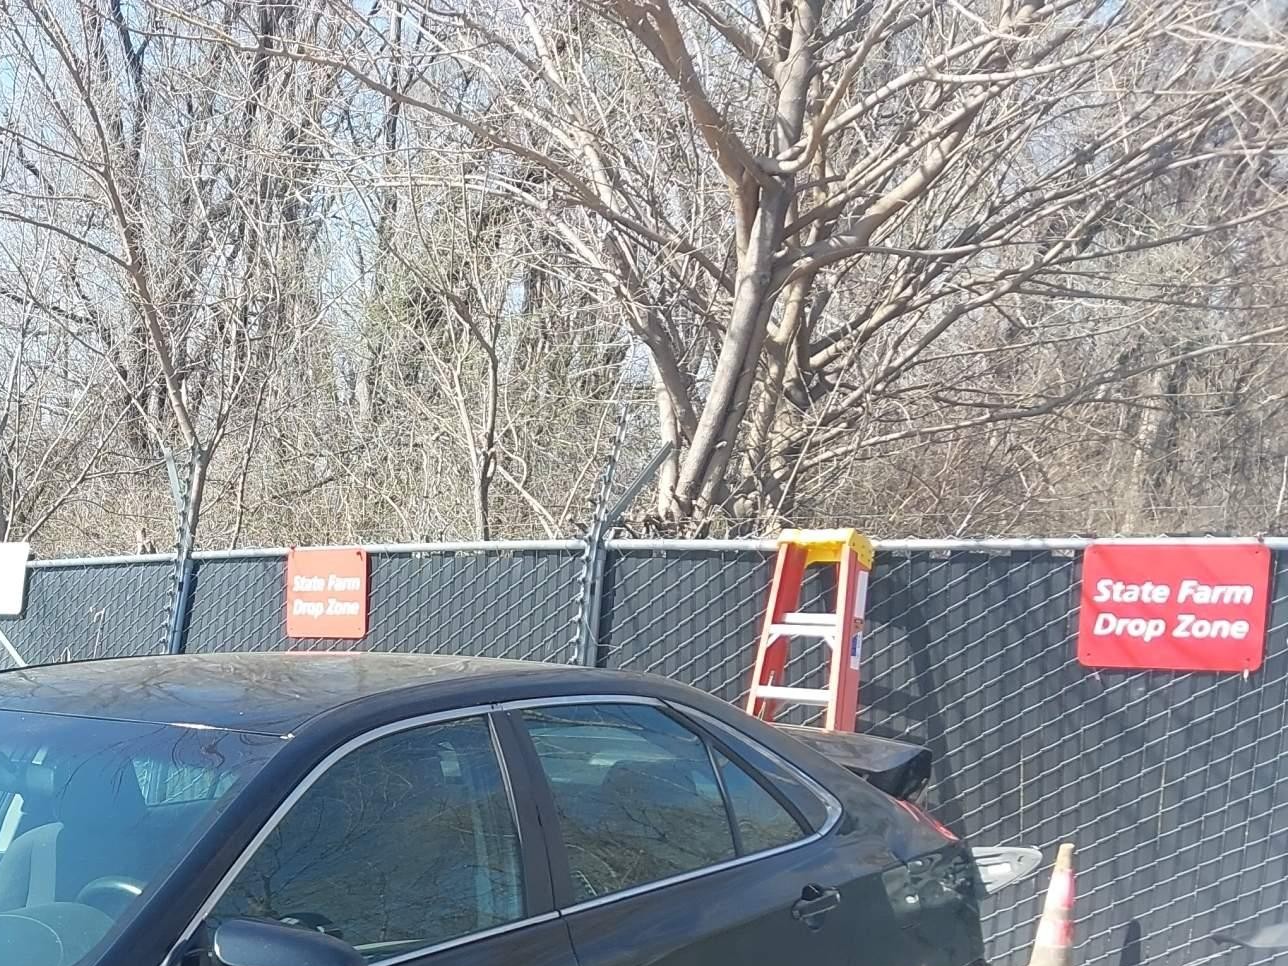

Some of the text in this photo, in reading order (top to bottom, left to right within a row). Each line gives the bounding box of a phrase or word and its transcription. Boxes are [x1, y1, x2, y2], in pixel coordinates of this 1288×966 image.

[293, 574, 361, 592] State Farm
[1093, 579, 1254, 605] State Farm
[293, 598, 360, 619] Drop Zone
[1093, 613, 1250, 642] Drop Zone
